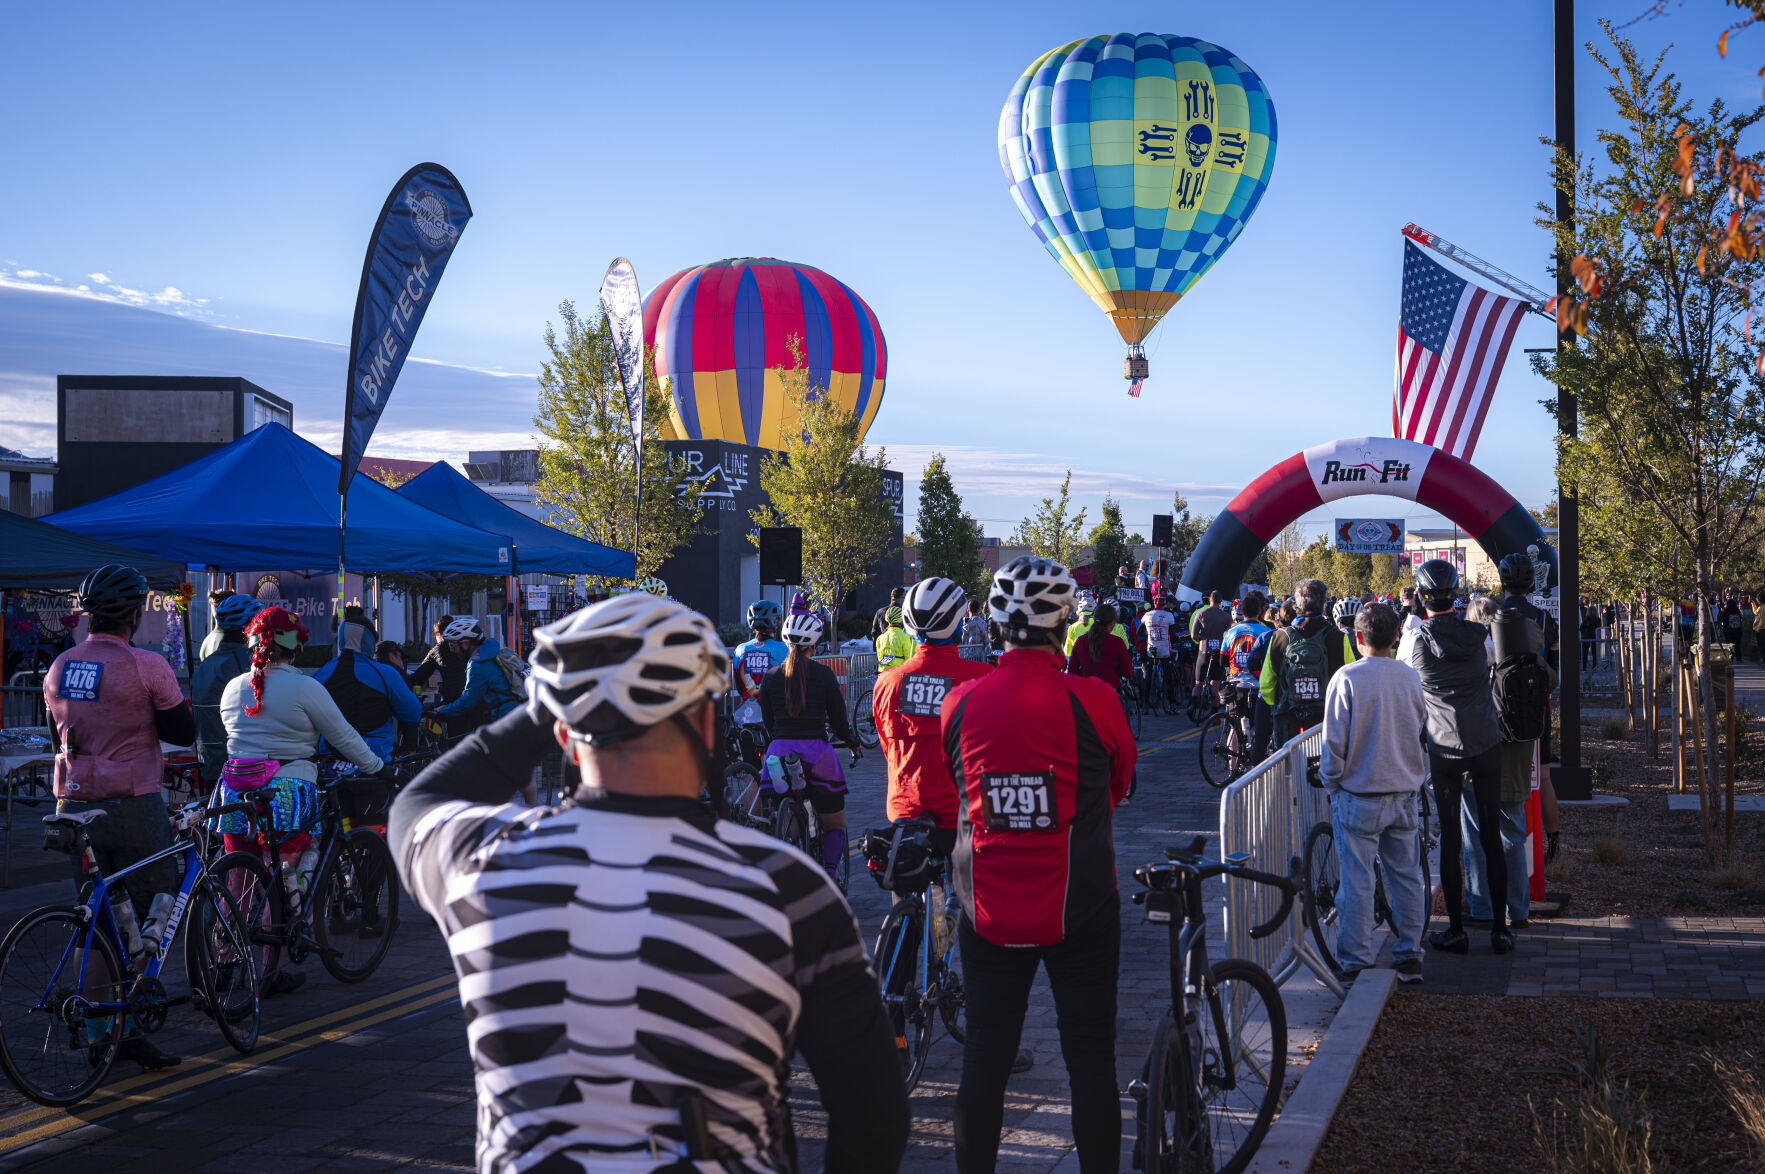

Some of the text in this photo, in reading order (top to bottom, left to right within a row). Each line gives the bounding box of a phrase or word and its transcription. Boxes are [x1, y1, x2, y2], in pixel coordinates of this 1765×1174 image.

[411, 201, 454, 235] PINNACLE
[361, 255, 430, 405] BIKE TECH
[724, 451, 749, 476] LINE
[1322, 459, 1410, 484] Run Fit
[882, 477, 900, 498] SPUR
[1337, 543, 1355, 551] DAY
[1373, 543, 1403, 551] TREAD
[296, 597, 325, 617] Bike
[745, 656, 769, 668] 1464
[65, 669, 97, 690] 1476
[1294, 681, 1320, 694] 1341
[905, 683, 946, 705] 1312
[990, 777, 1002, 786] DAY
[987, 786, 1049, 815] 1291
